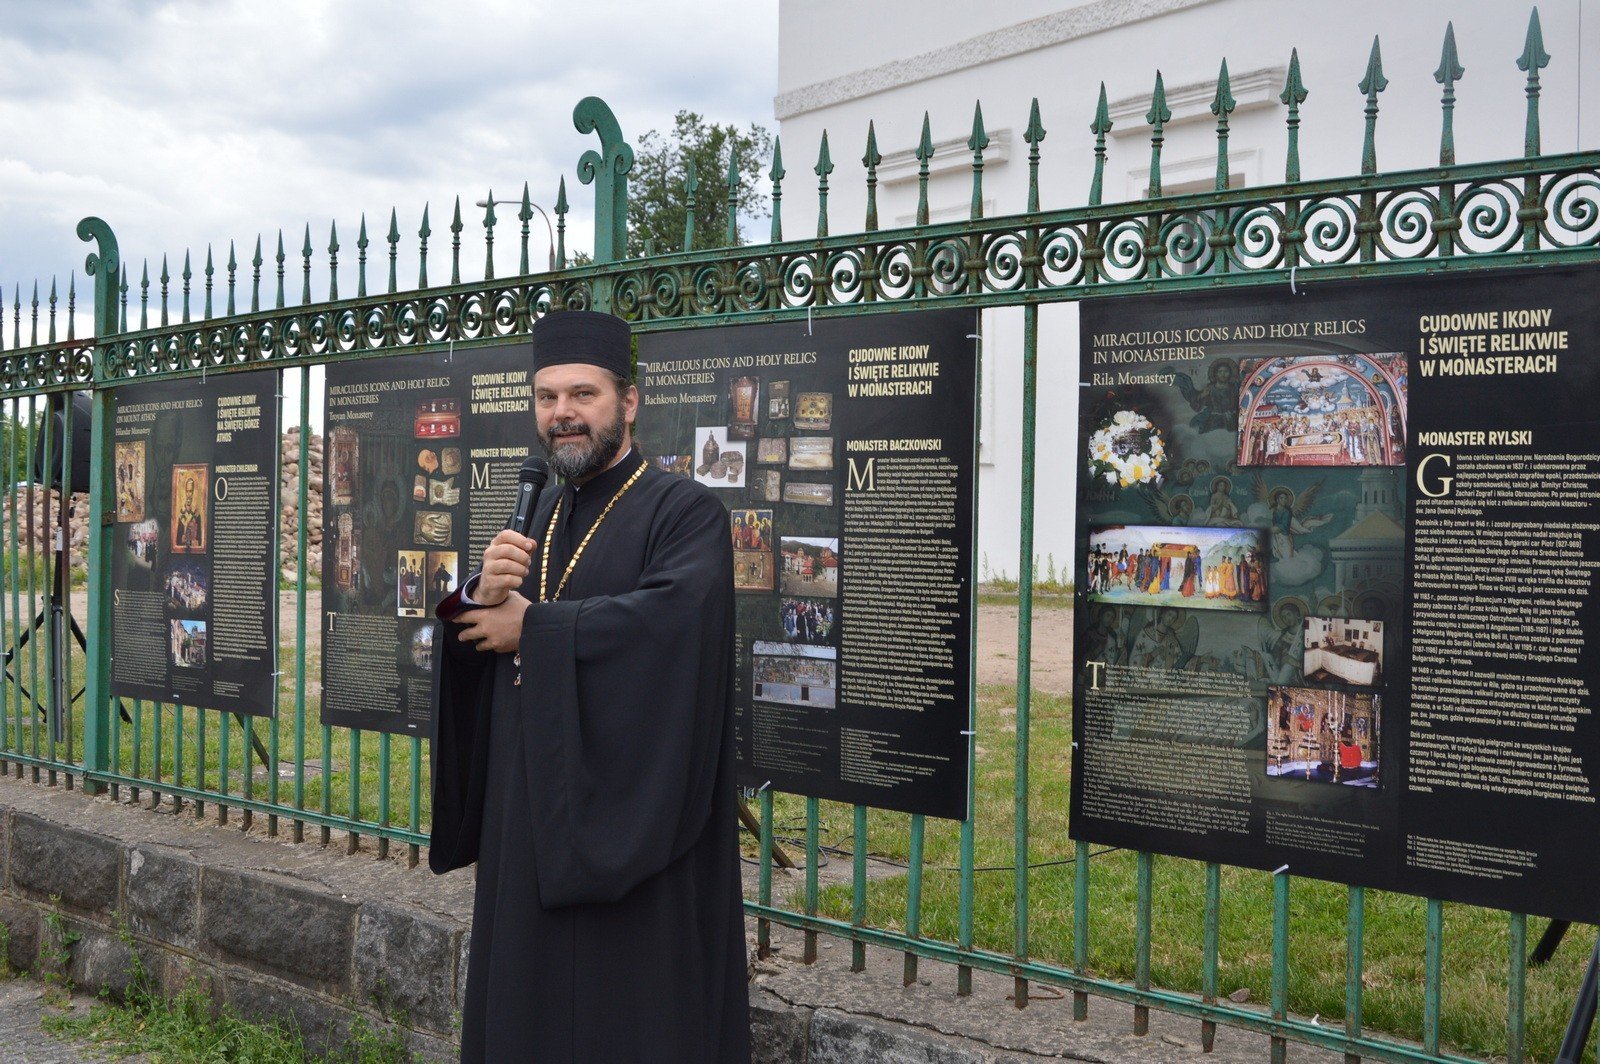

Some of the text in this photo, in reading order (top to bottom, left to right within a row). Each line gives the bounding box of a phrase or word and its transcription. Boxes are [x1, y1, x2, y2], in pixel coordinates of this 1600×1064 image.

[1420, 309, 1551, 332] CUDOWNE IKONY
[1094, 320, 1365, 346] MIRACULOUS ICONS AND HOLY RELICS
[1429, 334, 1486, 356] ŚWIĘTE
[1491, 332, 1568, 351] RELIKWIE
[849, 345, 929, 362] CUDOWNE IKONY
[1094, 347, 1205, 364] IN MONASTERIES
[646, 352, 816, 372] MIRACULOUS ICONS AND HOLY RELICS
[1420, 356, 1556, 376] W MONASTERACH
[472, 372, 527, 385] CUDOWNE IKONY
[854, 365, 889, 381] ŚWIĘTE
[892, 363, 939, 377] RELIKWIE
[330, 377, 450, 395] MIRACULOUS ICONS AND HOLY RELICS
[646, 373, 714, 386] IN MONASTERIES
[1094, 373, 1175, 386] Rila Monastery
[475, 388, 499, 401] ŚWIĘTE
[848, 381, 932, 397] W MONASTERACH
[330, 395, 379, 406] IN MONASTERIES
[645, 393, 717, 404] Bachkovo Monastery
[160, 402, 171, 410] AND
[472, 401, 528, 413] W MONASTERACH
[329, 411, 373, 421] Troyan Monastery
[217, 421, 224, 430] NA
[1419, 431, 1531, 445] MONASTER RYLSKI
[847, 439, 941, 451] MONASTER BACZKOWSKI
[471, 448, 499, 457] MONASTER
[1476, 490, 1493, 498] Zograf
[1560, 491, 1578, 499] prawej
